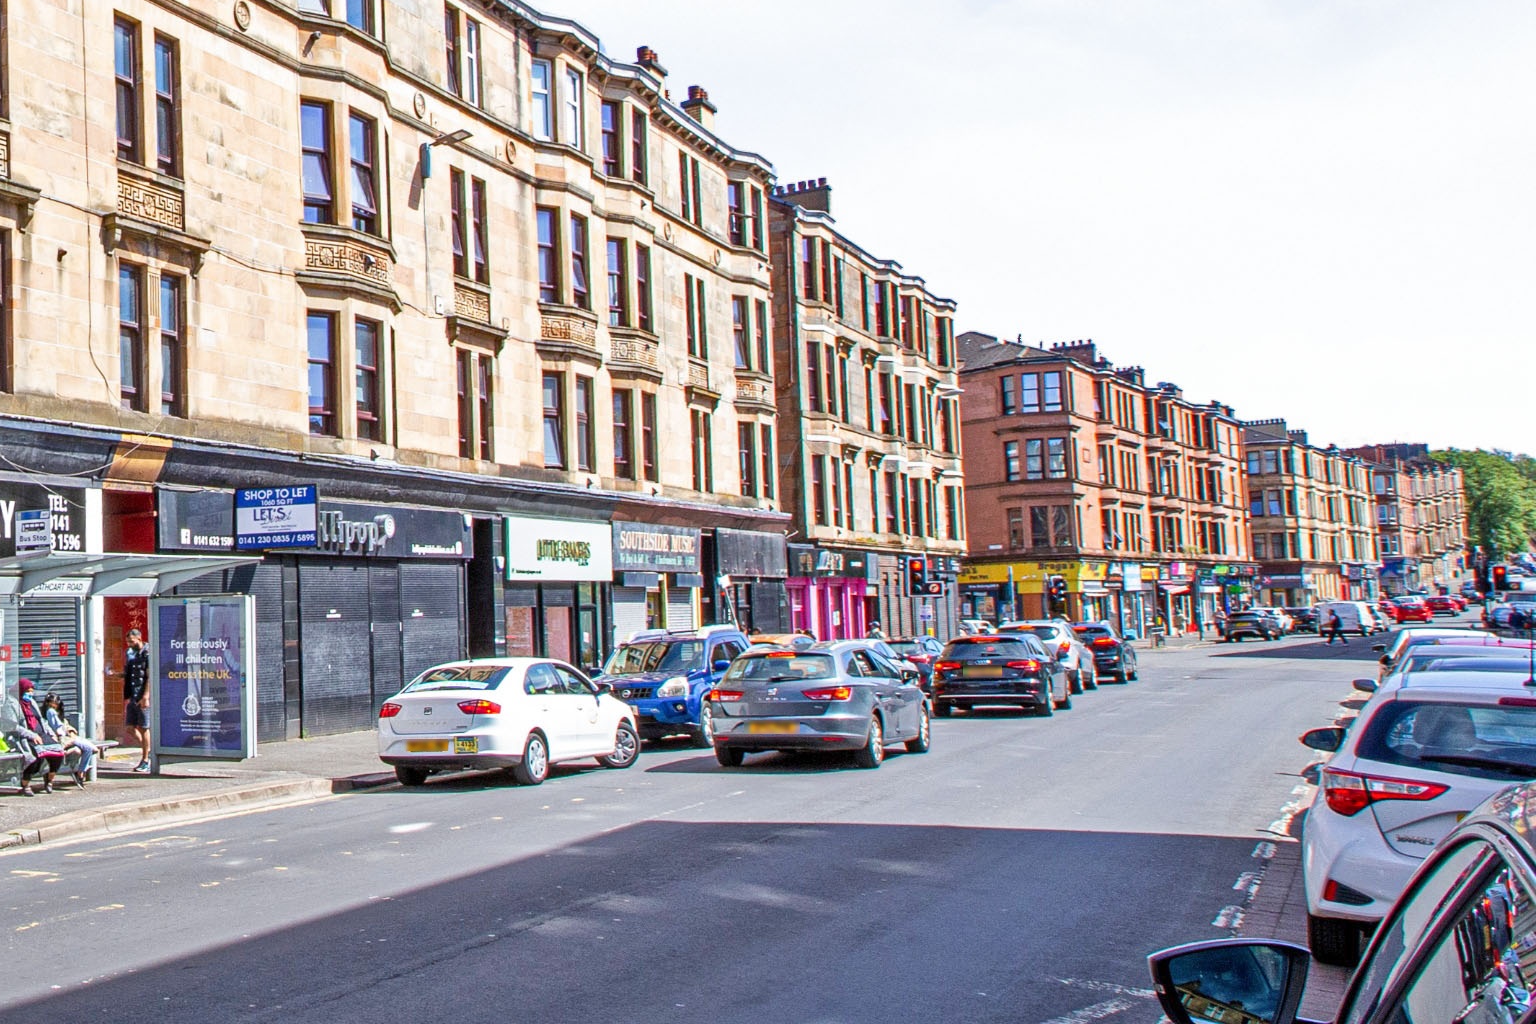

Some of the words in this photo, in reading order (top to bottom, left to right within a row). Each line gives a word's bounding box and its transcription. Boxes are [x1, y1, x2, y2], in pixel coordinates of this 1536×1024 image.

[244, 490, 273, 501] SHOP
[274, 488, 290, 499] TO
[291, 487, 308, 498] LET
[47, 494, 68, 512] TEL:
[253, 507, 286, 522] LET'S
[50, 514, 70, 531] 141
[320, 510, 379, 552] llipop
[19, 535, 31, 543] Bus
[32, 534, 47, 543] Stop
[57, 534, 81, 551] 1596
[193, 535, 209, 546] 0141
[238, 536, 256, 545] 0141
[257, 536, 272, 544] 230
[619, 530, 669, 552] SOUTHSIDE
[670, 534, 695, 553] MUSIC
[66, 583, 83, 591] ROAD
[170, 639, 185, 649] For
[186, 638, 228, 651] seriously
[176, 654, 184, 664] ill
[185, 654, 223, 664] children
[168, 670, 197, 679] across
[198, 669, 215, 679] the
[216, 669, 232, 679] UK.
